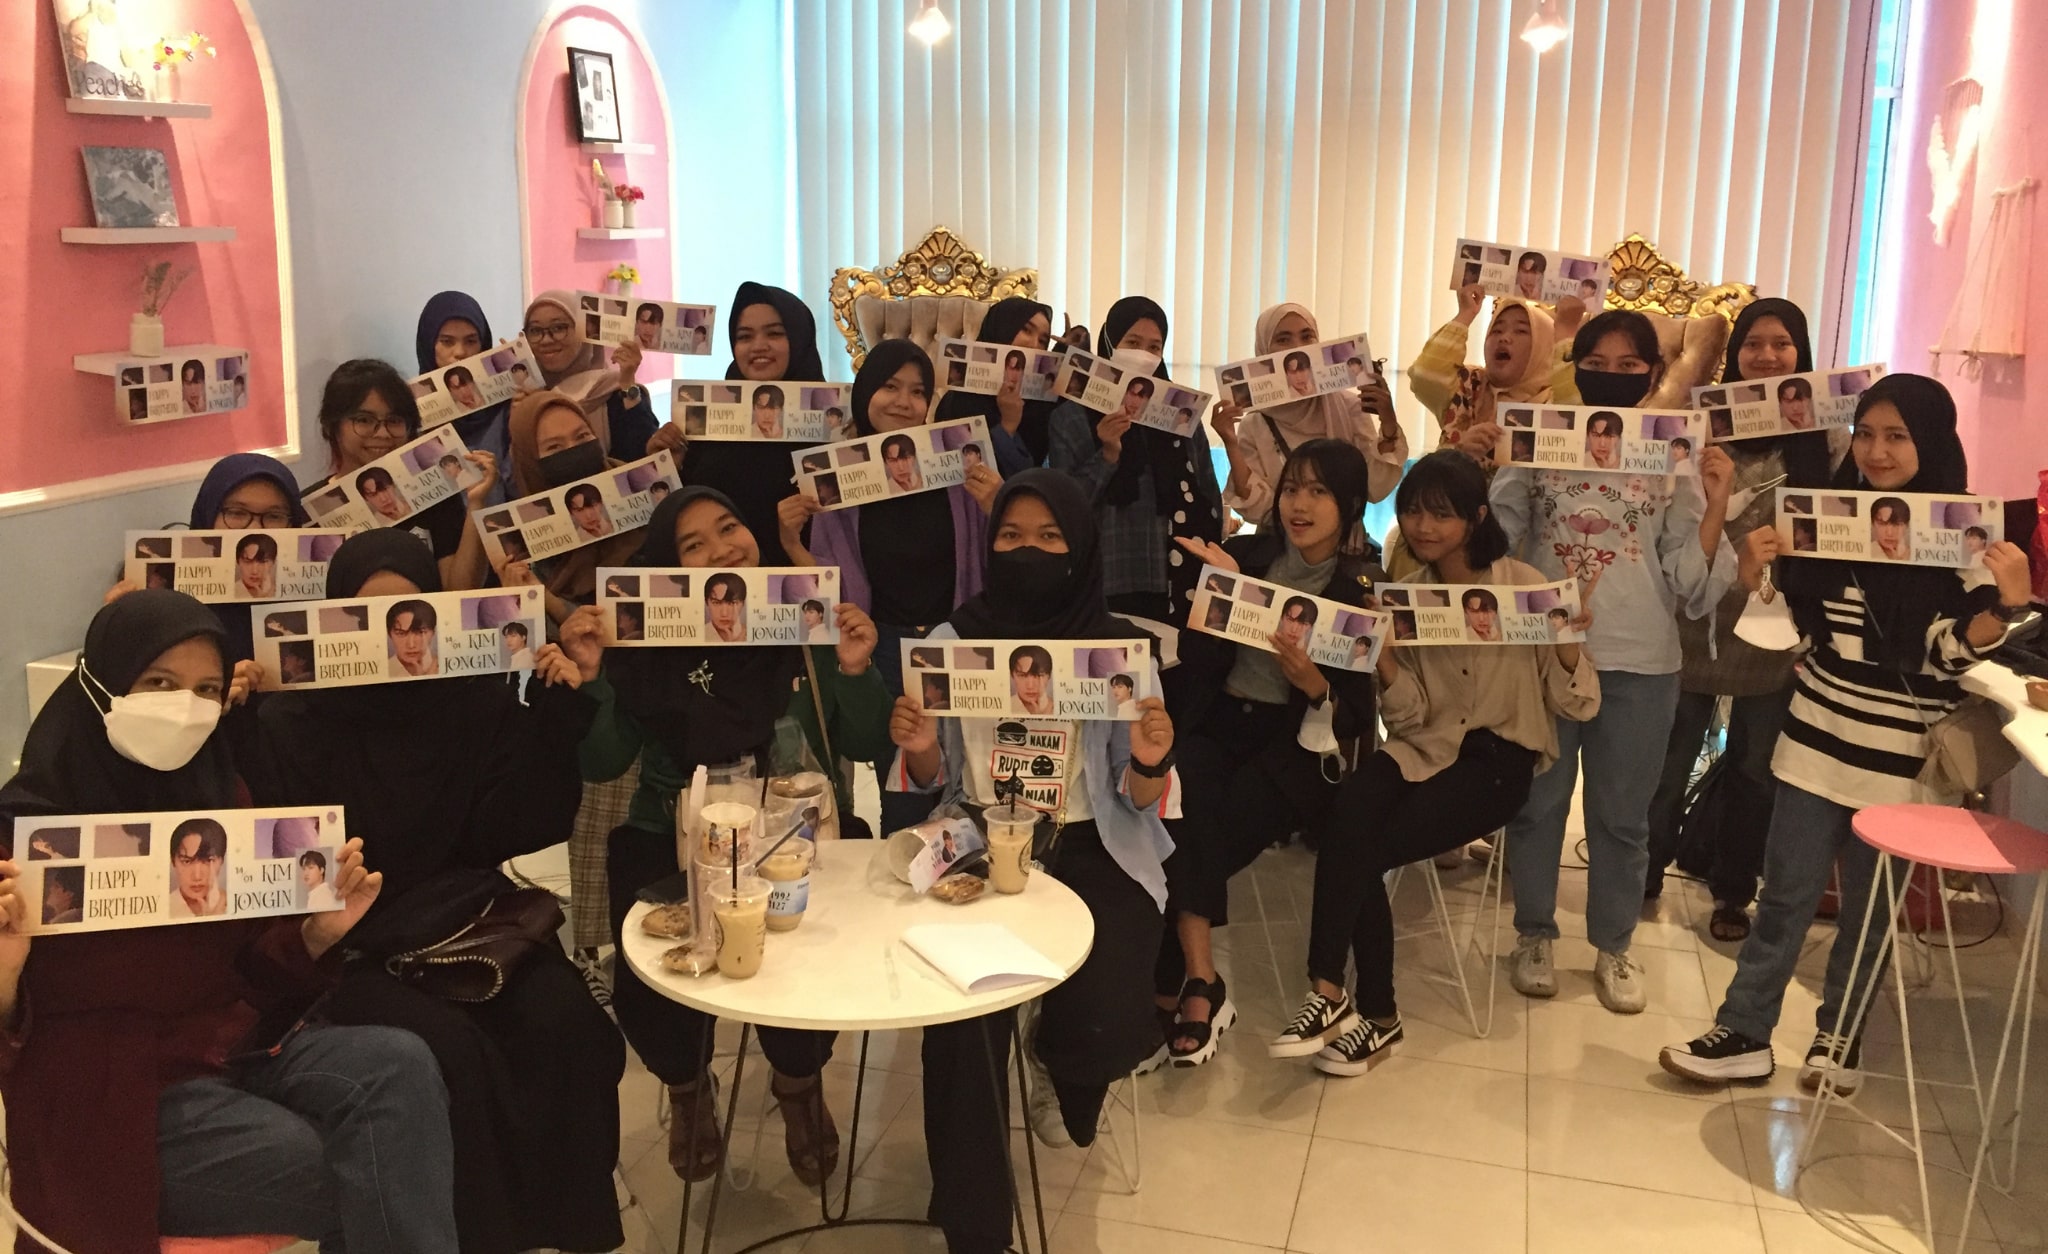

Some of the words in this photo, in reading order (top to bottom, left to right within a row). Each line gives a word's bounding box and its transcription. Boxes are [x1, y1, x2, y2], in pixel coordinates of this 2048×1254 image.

[1560, 281, 1578, 292] KIM
[1330, 366, 1346, 377] KIM
[709, 409, 734, 419] HAPPY
[804, 412, 822, 424] KIM
[1734, 408, 1761, 420] HAPPY
[708, 424, 745, 435] BIRTHDAY
[787, 427, 822, 439] JONGIN
[1736, 419, 1776, 433] BIRTHDAY
[1538, 435, 1566, 447] HAPPY
[1644, 442, 1665, 455] KIM
[940, 454, 960, 468] KIM
[1537, 452, 1577, 464] BIRTHDAY
[1624, 458, 1664, 471] JONGIN
[419, 470, 441, 486] KIM
[839, 471, 867, 484] HAPPY
[926, 470, 963, 487] JONGIN
[412, 484, 448, 510] JONGIN
[843, 483, 883, 499] BIRTHDAY
[628, 494, 650, 510] KIM
[525, 524, 554, 541] HAPPY
[1820, 523, 1850, 535] HAPPY
[531, 535, 573, 556] BIRTHDAY
[1936, 532, 1959, 546] KIM
[1821, 540, 1865, 553] BIRTHDAY
[1914, 549, 1958, 562] JONGIN
[178, 566, 213, 578] HAPPY
[302, 565, 324, 579] KIM
[178, 583, 227, 596] BIRTHDAY
[280, 582, 324, 598] JONGIN
[648, 606, 682, 620] HAPPY
[773, 608, 796, 623] KIM
[1233, 606, 1261, 623] HAPPY
[1418, 613, 1446, 623] HAPPY
[1523, 616, 1544, 627] KIM
[648, 625, 697, 639] BIRTHDAY
[752, 627, 796, 643] JONGIN
[1420, 627, 1460, 639] BIRTHDAY
[1506, 631, 1546, 641] JONGIN
[468, 633, 496, 650] KIM
[1330, 636, 1350, 650] KIM
[318, 641, 360, 659] HAPPY
[1309, 648, 1346, 664] JONGIN
[320, 661, 379, 680] BIRTHDAY
[444, 653, 496, 674] JONGIN
[953, 678, 987, 691] HAPPY
[1080, 682, 1104, 696] KIM
[954, 696, 1003, 710] BIRTHDAY
[1059, 701, 1104, 715] JONGIN
[1030, 735, 1060, 750] NAKAM
[998, 756, 1029, 772] RUDIT
[1026, 789, 1057, 806] NIAM
[90, 869, 138, 889] HAPPY
[262, 863, 291, 883] KIM
[89, 896, 160, 919] BIRTHDAY
[233, 889, 291, 914] JONGIN
